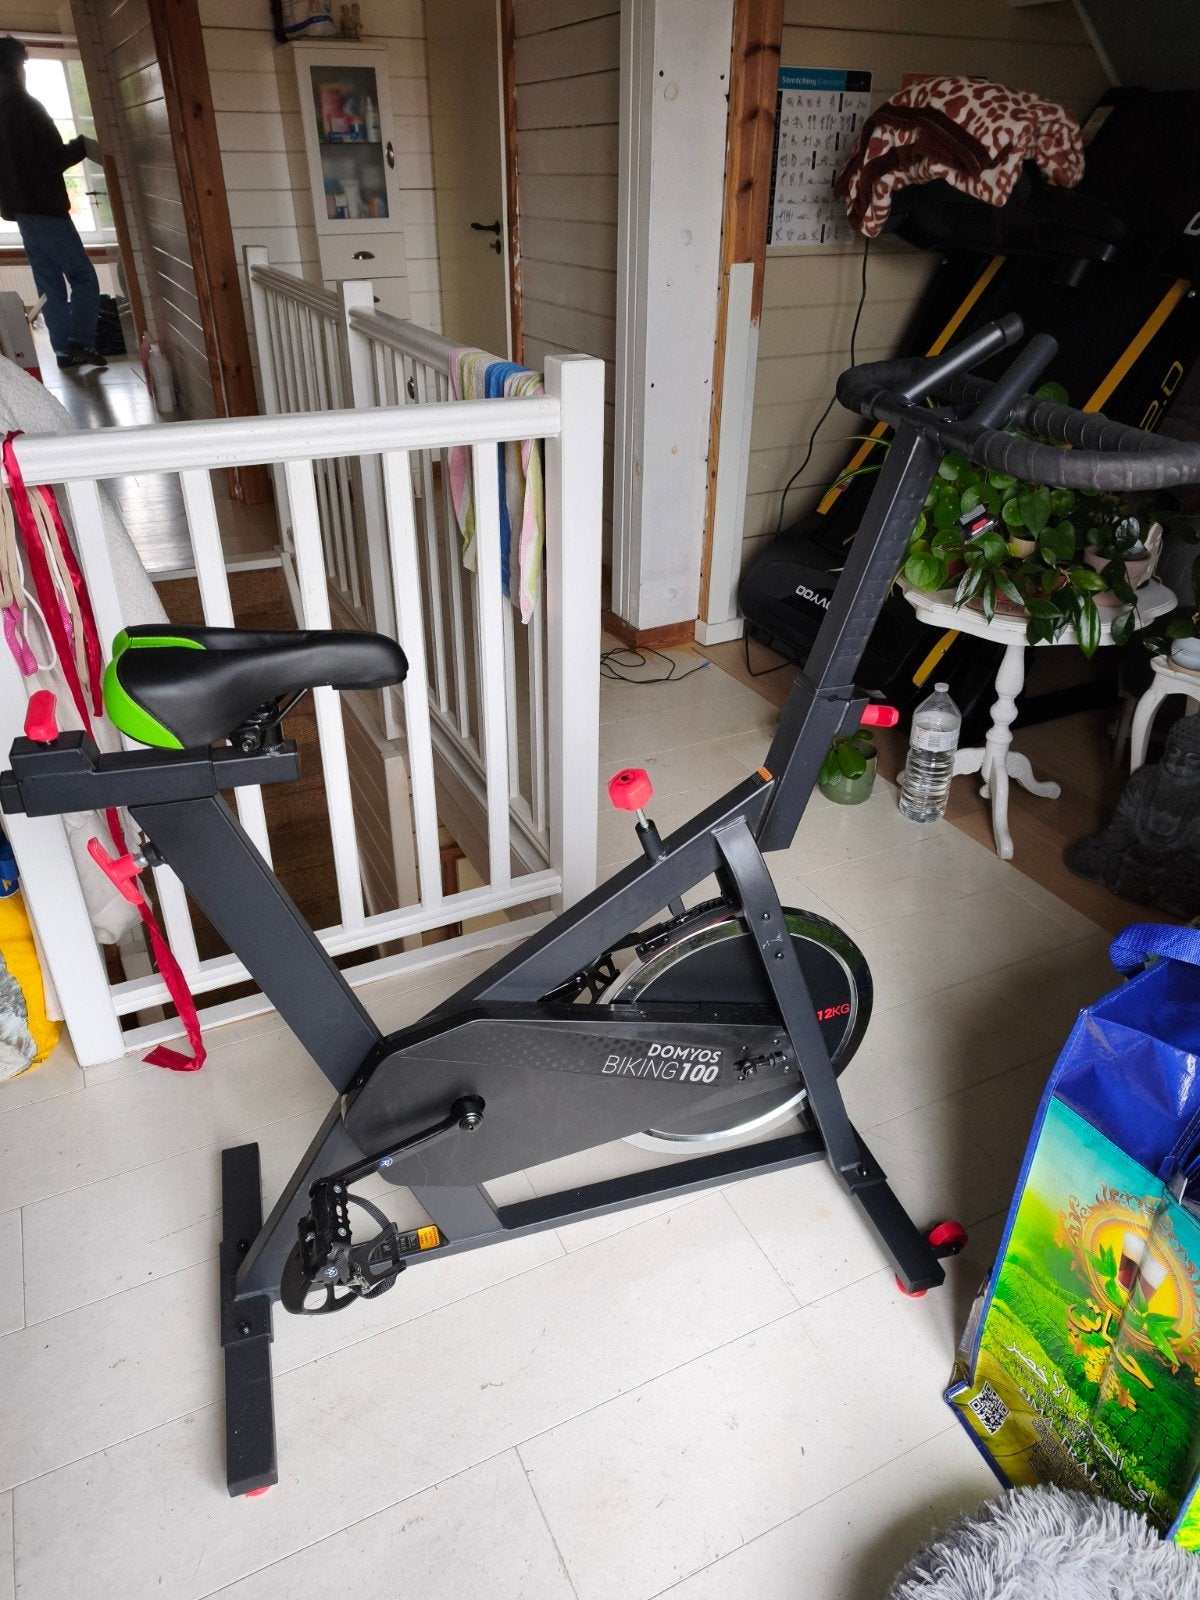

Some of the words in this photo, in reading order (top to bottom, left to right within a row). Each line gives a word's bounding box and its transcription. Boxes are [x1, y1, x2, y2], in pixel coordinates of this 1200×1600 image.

[782, 76, 817, 87] Stretching
[817, 1003, 850, 1021] 12KG
[647, 1043, 721, 1063] DOMYOS
